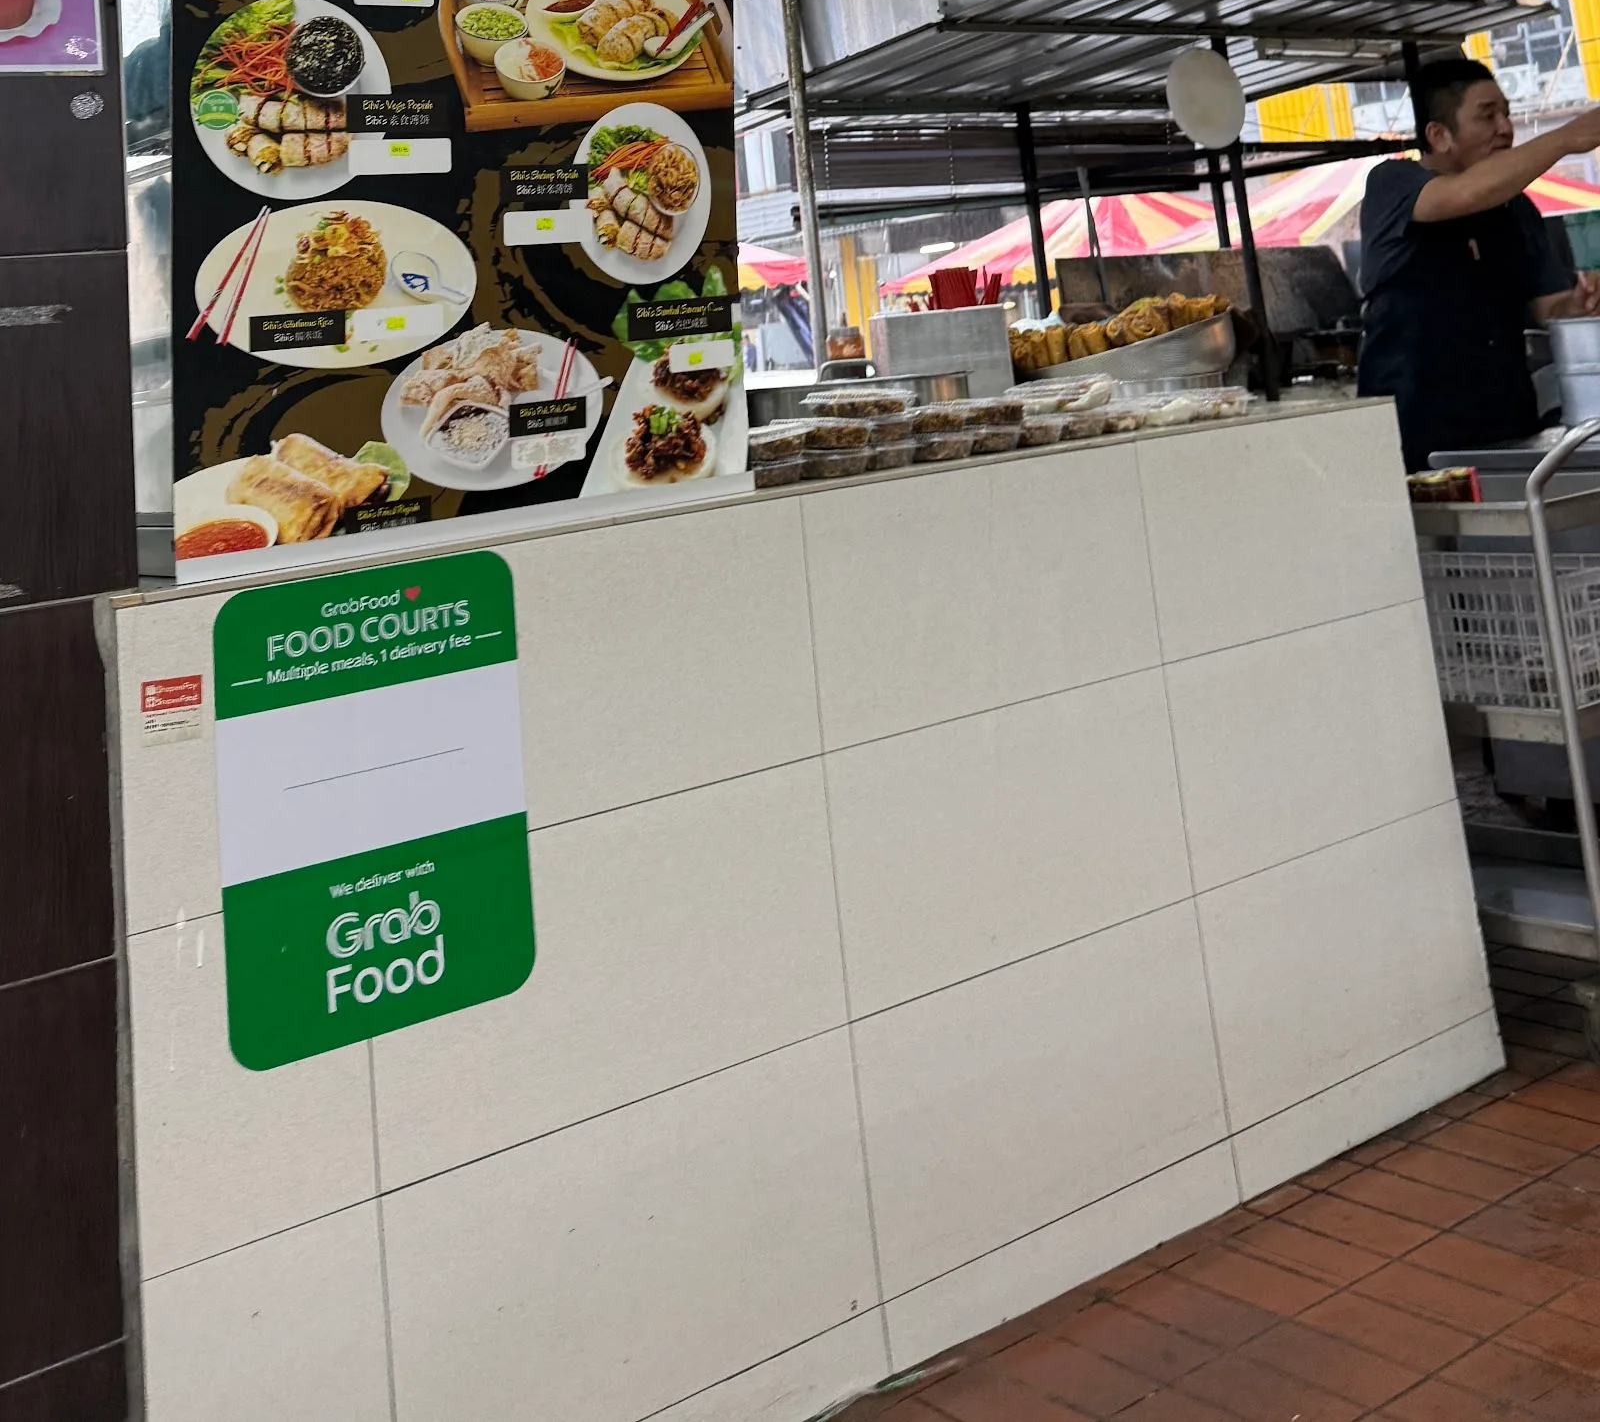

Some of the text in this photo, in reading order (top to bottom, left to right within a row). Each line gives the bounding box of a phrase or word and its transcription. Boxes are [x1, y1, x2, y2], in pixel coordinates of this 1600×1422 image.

[266, 599, 471, 662] FOOD COURTS
[320, 588, 401, 618] GrabFood
[266, 633, 472, 685] Multiple meals, 1 delivery fee
[328, 859, 436, 899] We deliver with
[325, 890, 441, 959] Grab
[326, 933, 446, 1014] Food
